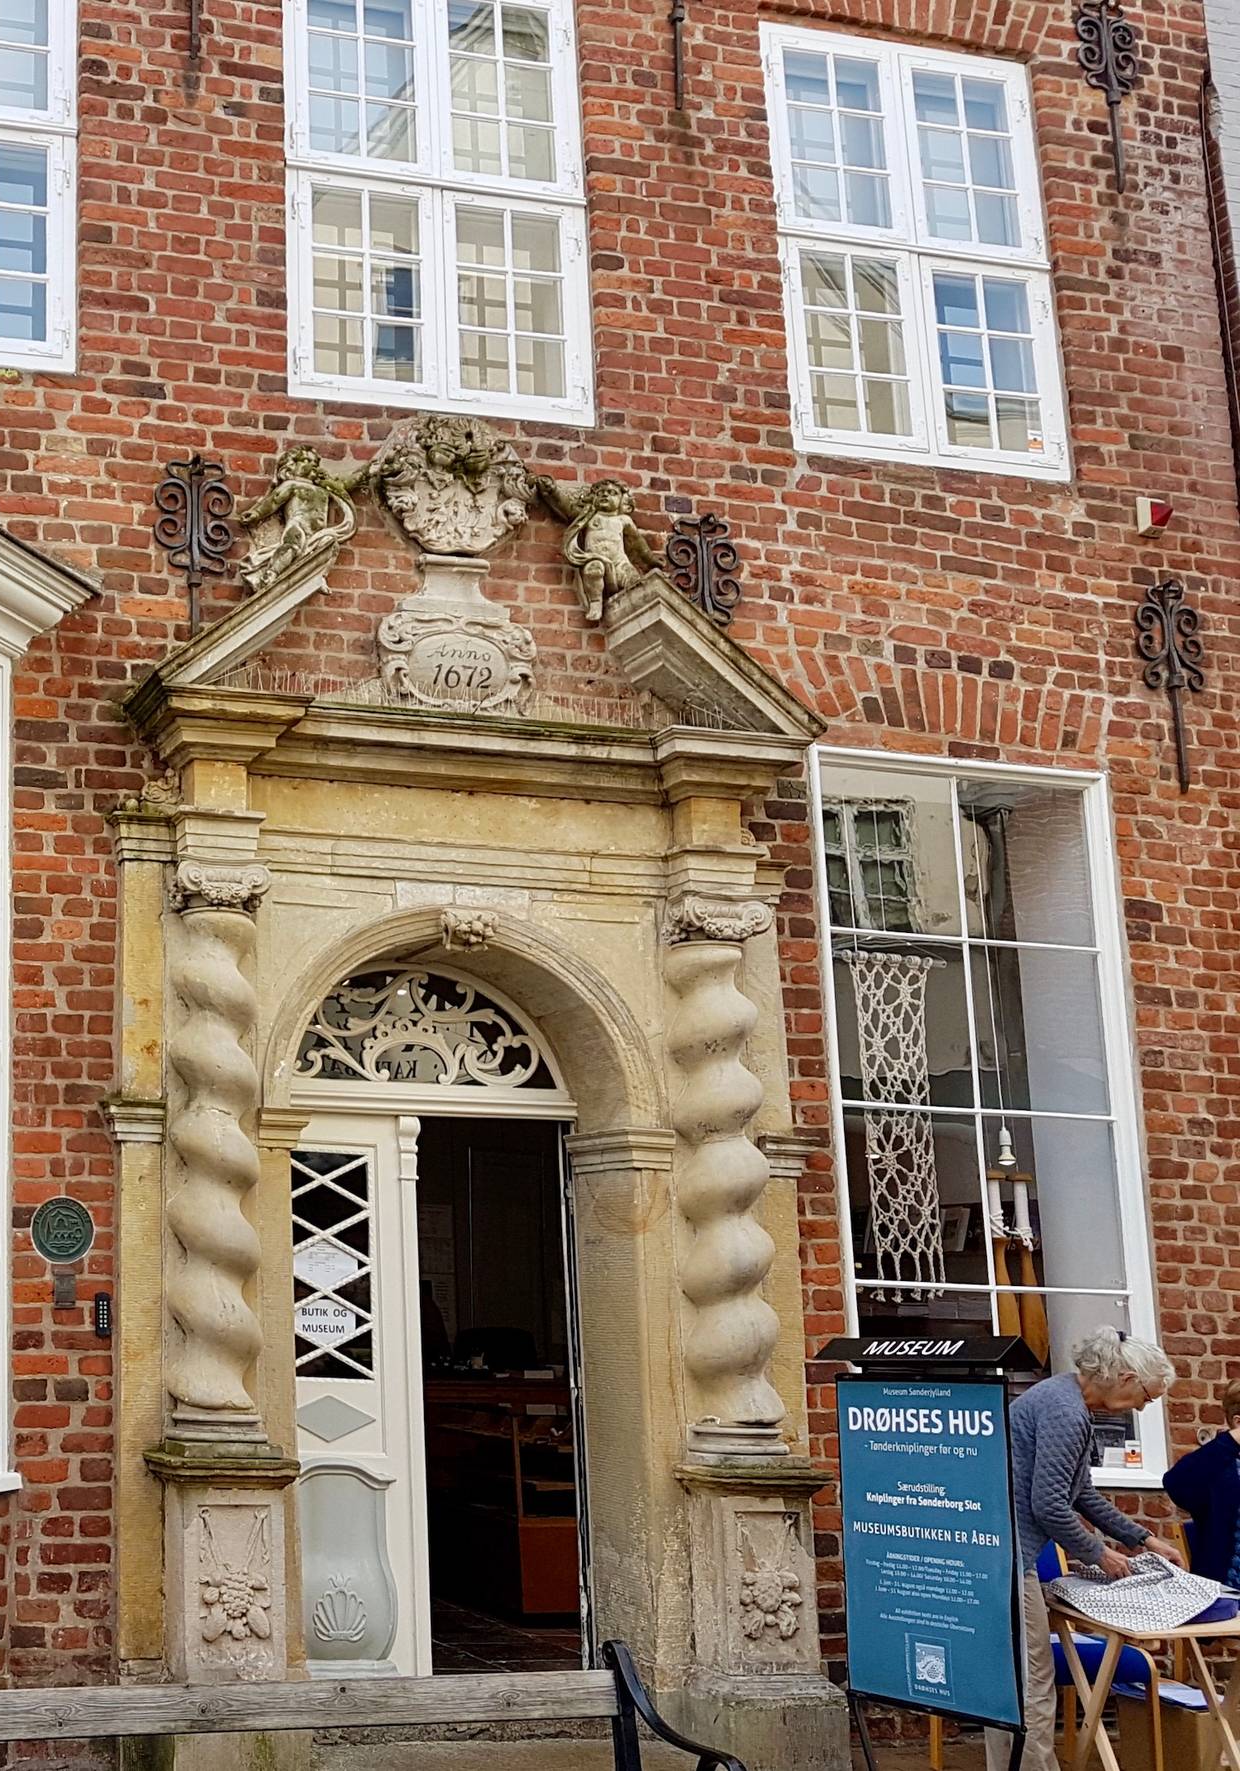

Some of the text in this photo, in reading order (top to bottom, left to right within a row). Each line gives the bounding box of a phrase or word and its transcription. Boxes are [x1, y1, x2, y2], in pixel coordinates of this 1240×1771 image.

[427, 640, 491, 662] Anno
[432, 663, 493, 689] 1672
[301, 1307, 348, 1318] BUTIK OG
[302, 1324, 345, 1334] MUSEUM
[862, 1340, 965, 1356] MUSEUM
[883, 1387, 908, 1396] Museum
[848, 1406, 994, 1436] DRØHSES HUS
[870, 1440, 937, 1456] Tønderkniplinger
[939, 1443, 951, 1455] før
[953, 1446, 965, 1458] og
[966, 1447, 978, 1456] nu
[866, 1492, 981, 1512] Kniplinger fra Sønderborg Slot
[853, 1520, 1000, 1547] MUSEUMSBUTIKKEN ER ÅBEN
